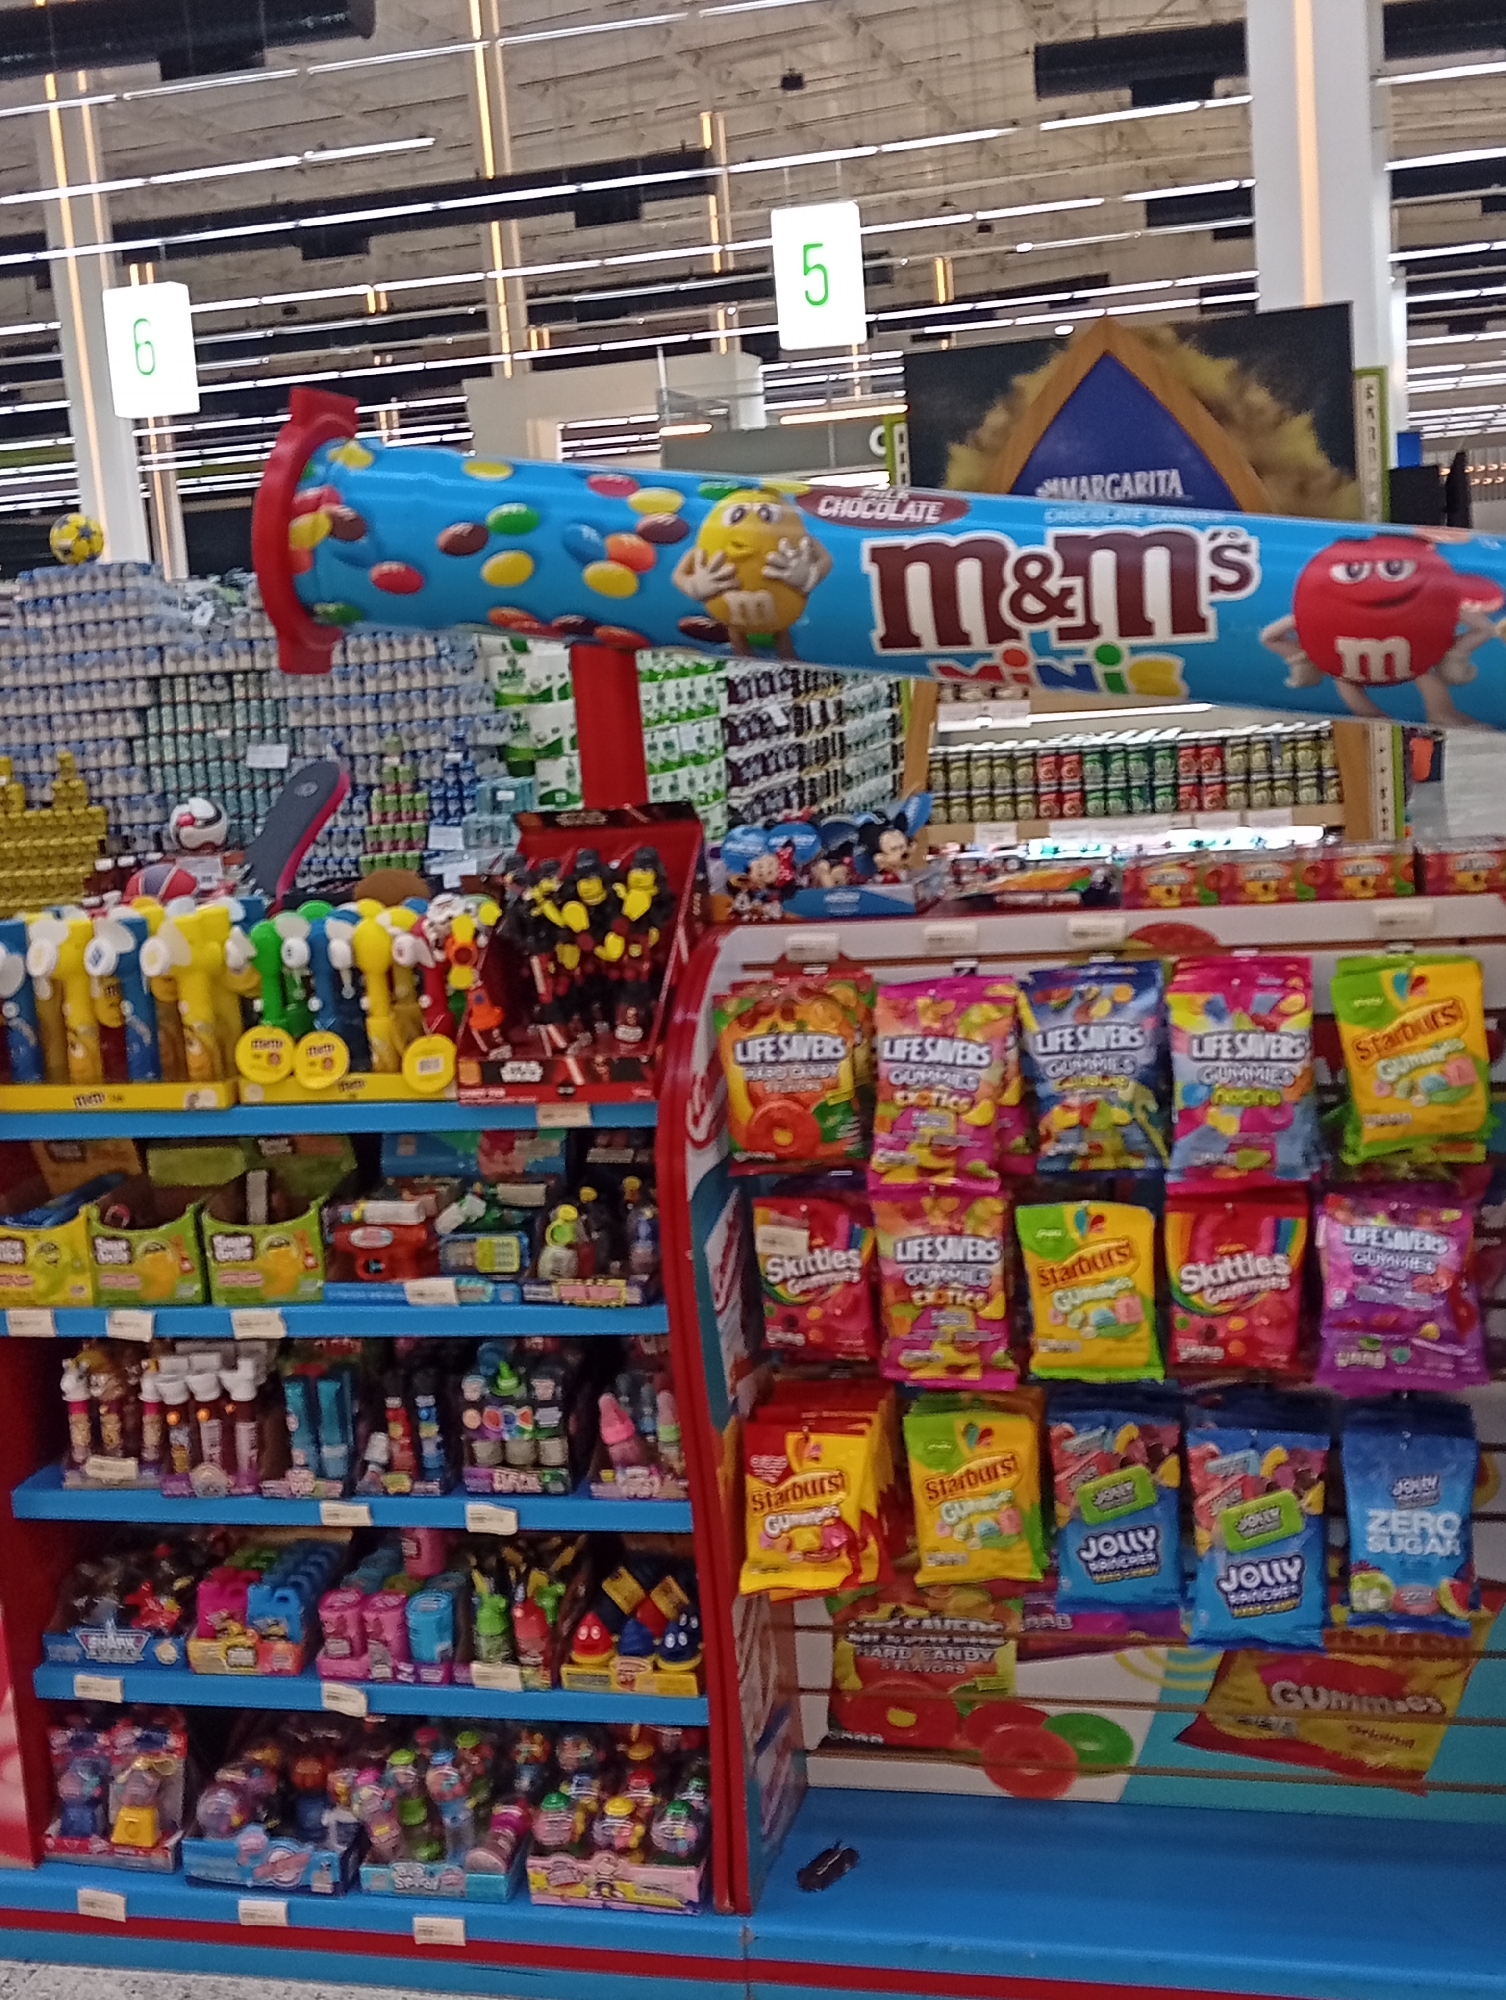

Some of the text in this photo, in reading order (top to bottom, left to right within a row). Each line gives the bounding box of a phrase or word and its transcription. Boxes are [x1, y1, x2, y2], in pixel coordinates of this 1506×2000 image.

[803, 243, 829, 306] 5
[132, 318, 156, 376] 6
[817, 495, 944, 524] CHOCOLATE
[1335, 636, 1415, 682] m
[766, 1246, 863, 1285] Skittles
[1180, 1251, 1293, 1293] Skittles
[1367, 1509, 1462, 1537] ZERO
[1078, 1525, 1158, 1562] JOLLY
[1367, 1536, 1462, 1557] SUGAR
[1216, 1556, 1305, 1594] JOLLY
[856, 1645, 996, 1662] HARD CANDY
